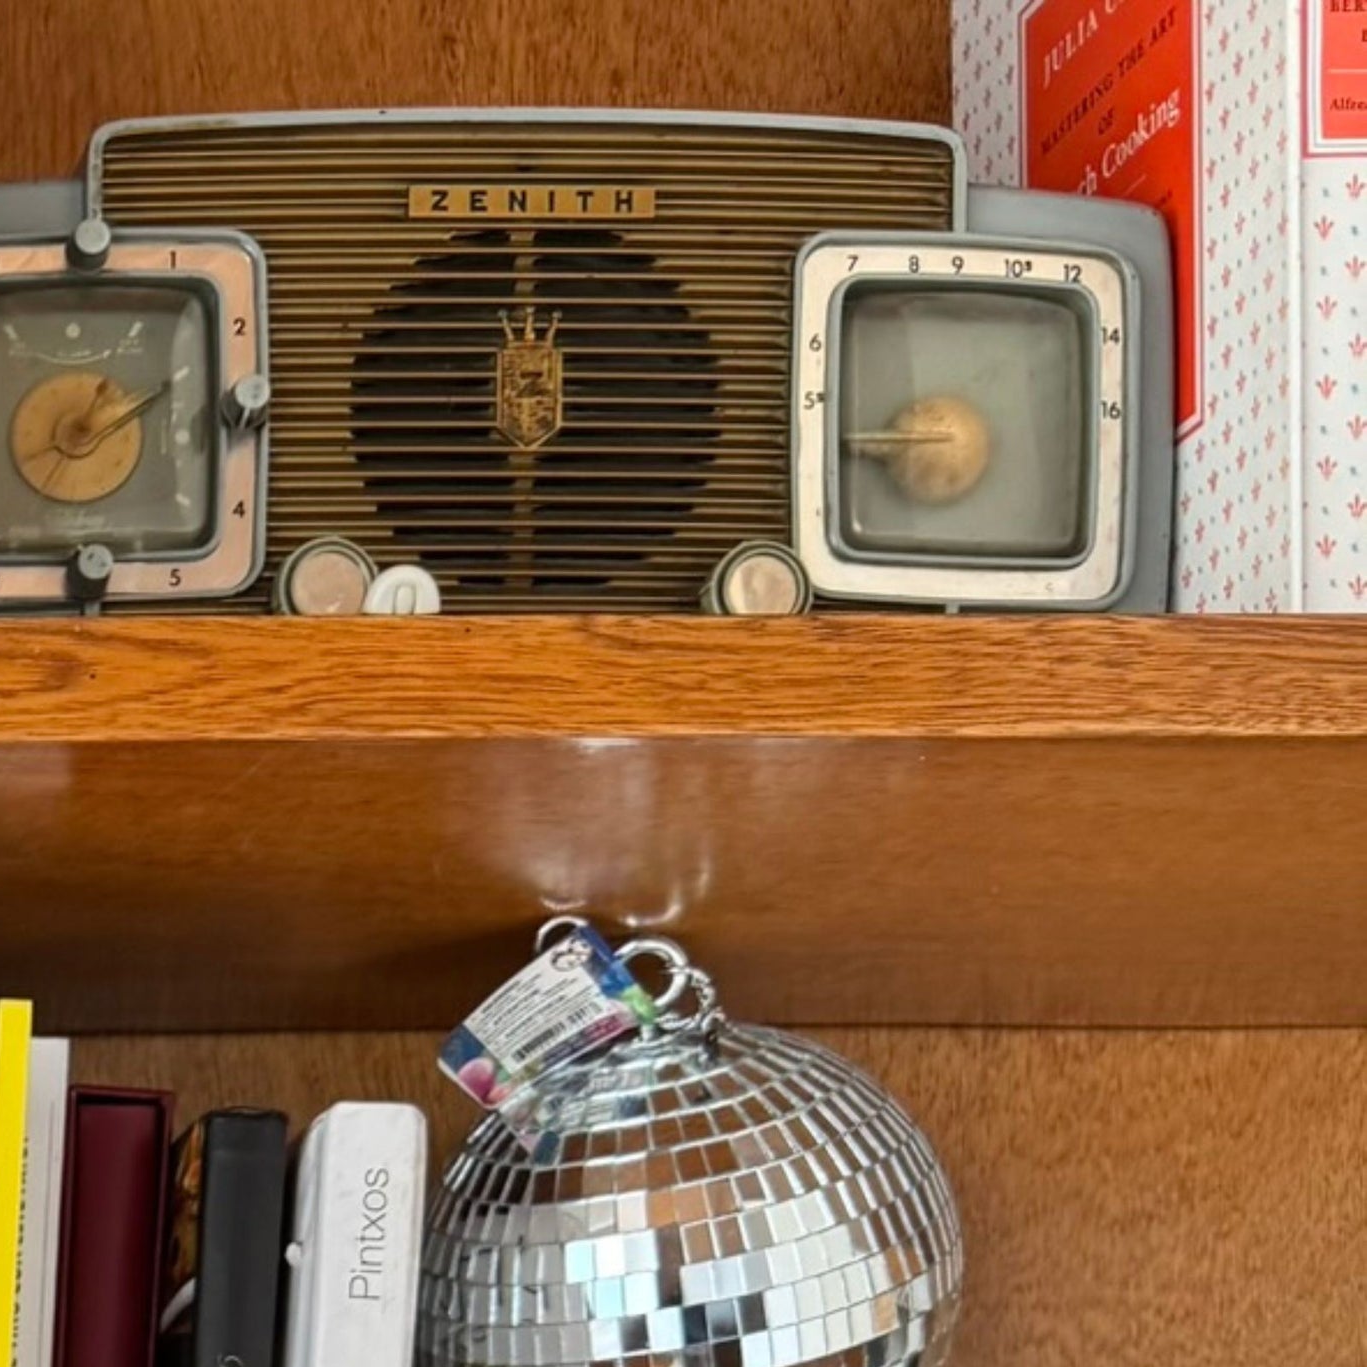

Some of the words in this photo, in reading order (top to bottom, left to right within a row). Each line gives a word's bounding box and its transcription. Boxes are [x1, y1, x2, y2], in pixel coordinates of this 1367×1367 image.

[1043, 9, 1100, 89] JULIA
[1118, 38, 1145, 78] THE
[1149, 6, 1178, 49] ART
[1101, 87, 1181, 180] Cooking
[431, 190, 634, 212] ZENITH
[170, 252, 177, 269] 1
[847, 255, 859, 271] 7
[908, 256, 920, 273] 8
[951, 256, 964, 274] 9
[1063, 264, 1082, 283] 12
[233, 318, 246, 336] 2
[1103, 327, 1121, 345] 14
[809, 333, 822, 352] 6
[1102, 401, 1122, 419] 16
[233, 500, 246, 518] 4
[169, 569, 181, 587] 5
[349, 1166, 390, 1301] Pintxos
